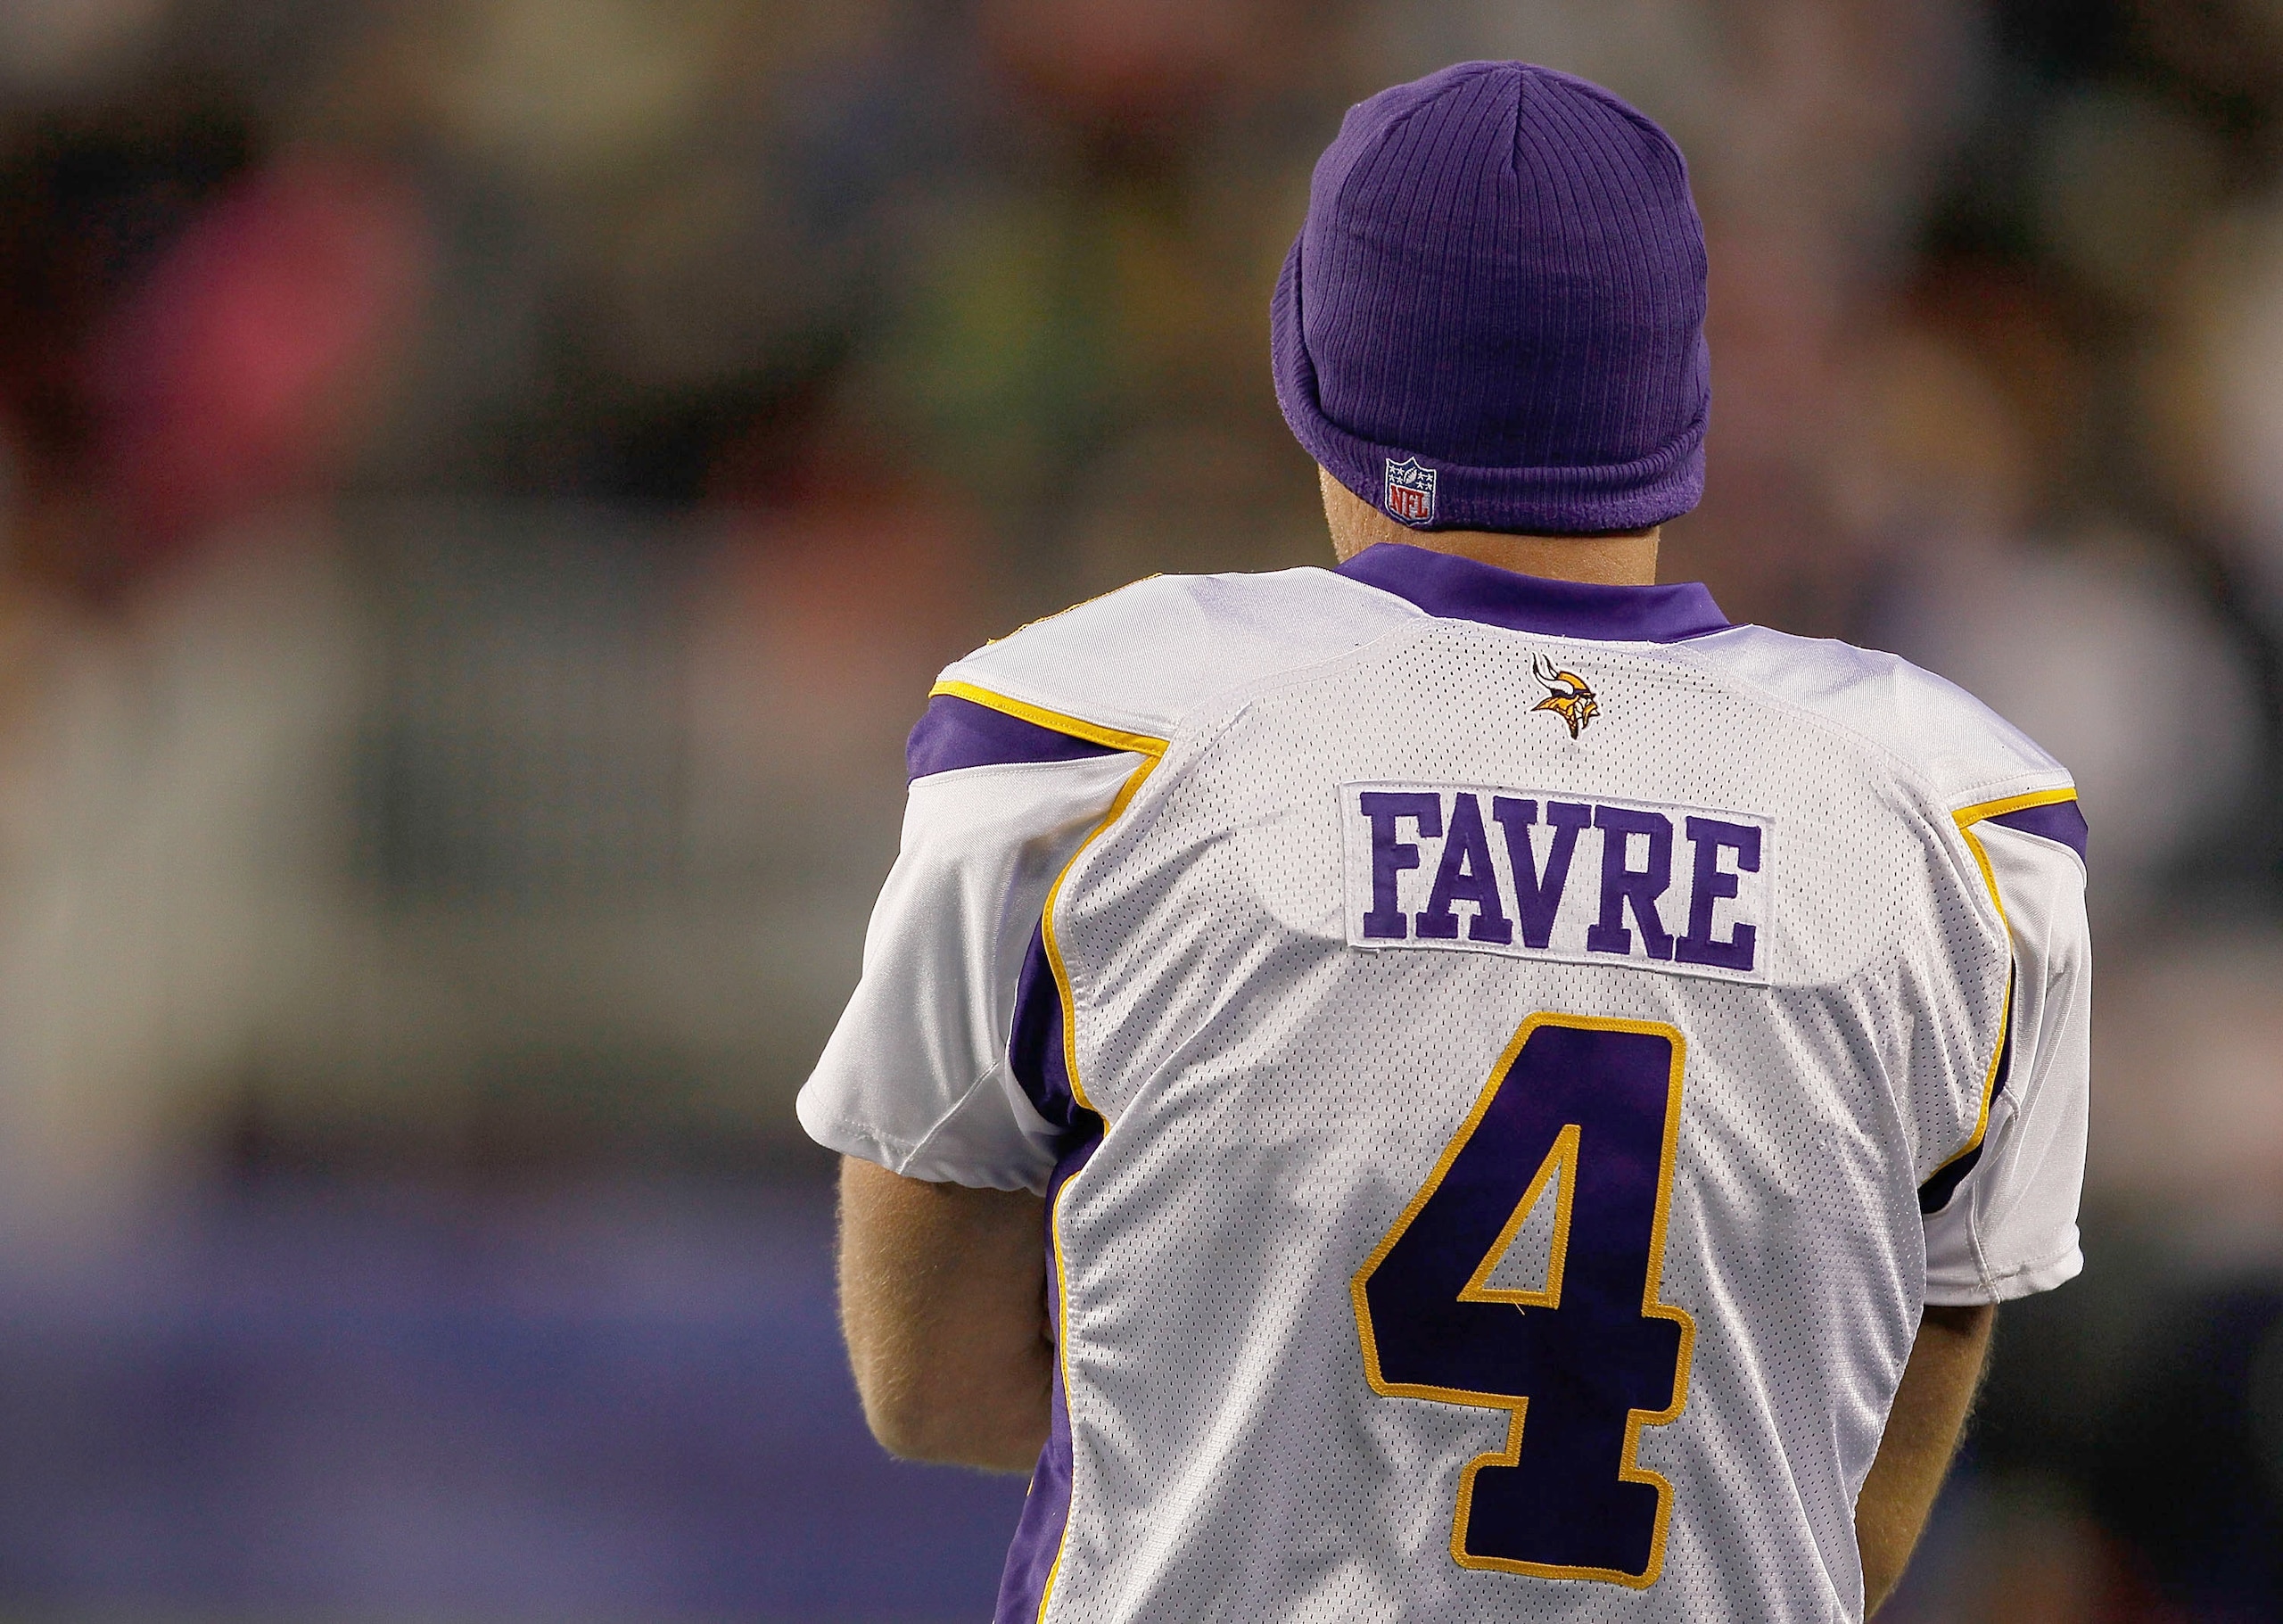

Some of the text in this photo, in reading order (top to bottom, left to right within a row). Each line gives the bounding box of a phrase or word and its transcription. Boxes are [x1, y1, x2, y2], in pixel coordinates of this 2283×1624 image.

[1389, 485, 1429, 519] NFL
[1359, 792, 1761, 970] FAVRE
[1350, 1011, 1695, 1589] 4
